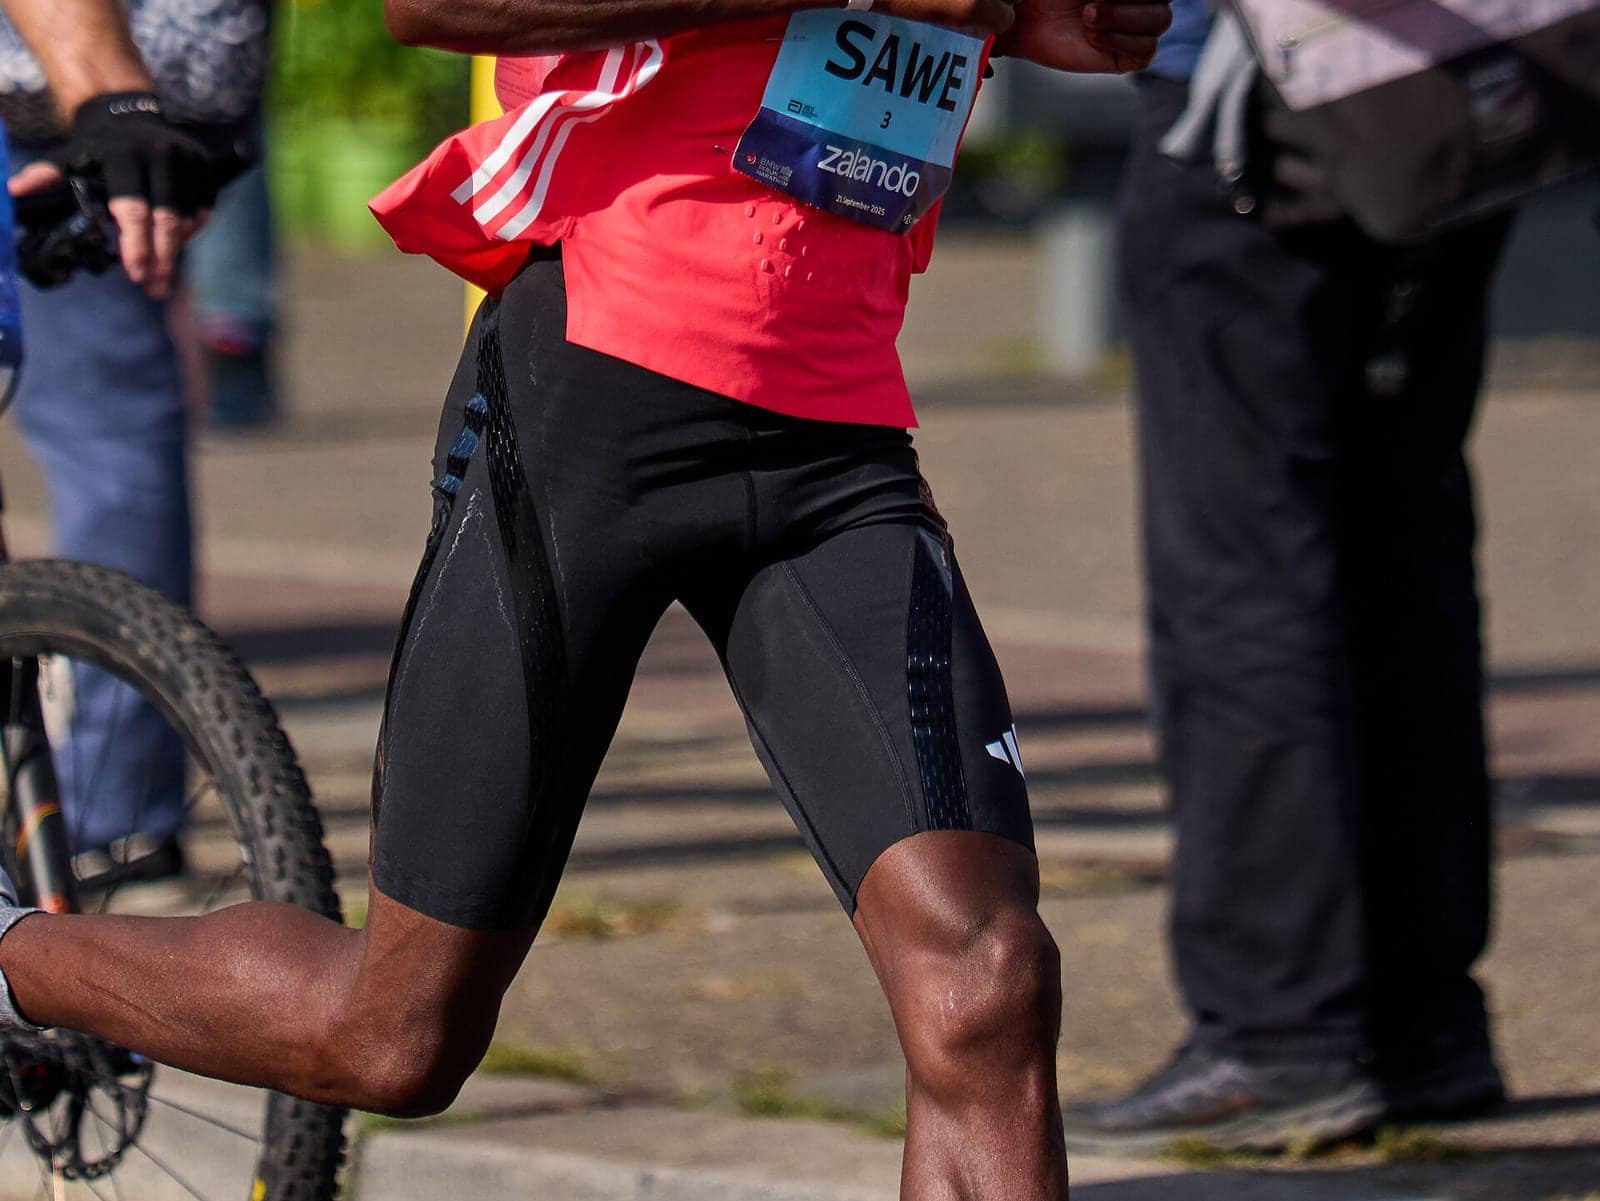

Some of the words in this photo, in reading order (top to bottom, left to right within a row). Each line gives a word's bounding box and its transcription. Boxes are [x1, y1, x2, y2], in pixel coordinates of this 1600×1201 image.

[824, 20, 967, 112] SAWE
[880, 111, 892, 129] 3
[817, 144, 920, 197] zalando
[842, 196, 870, 211] September
[870, 204, 886, 216] 2025
